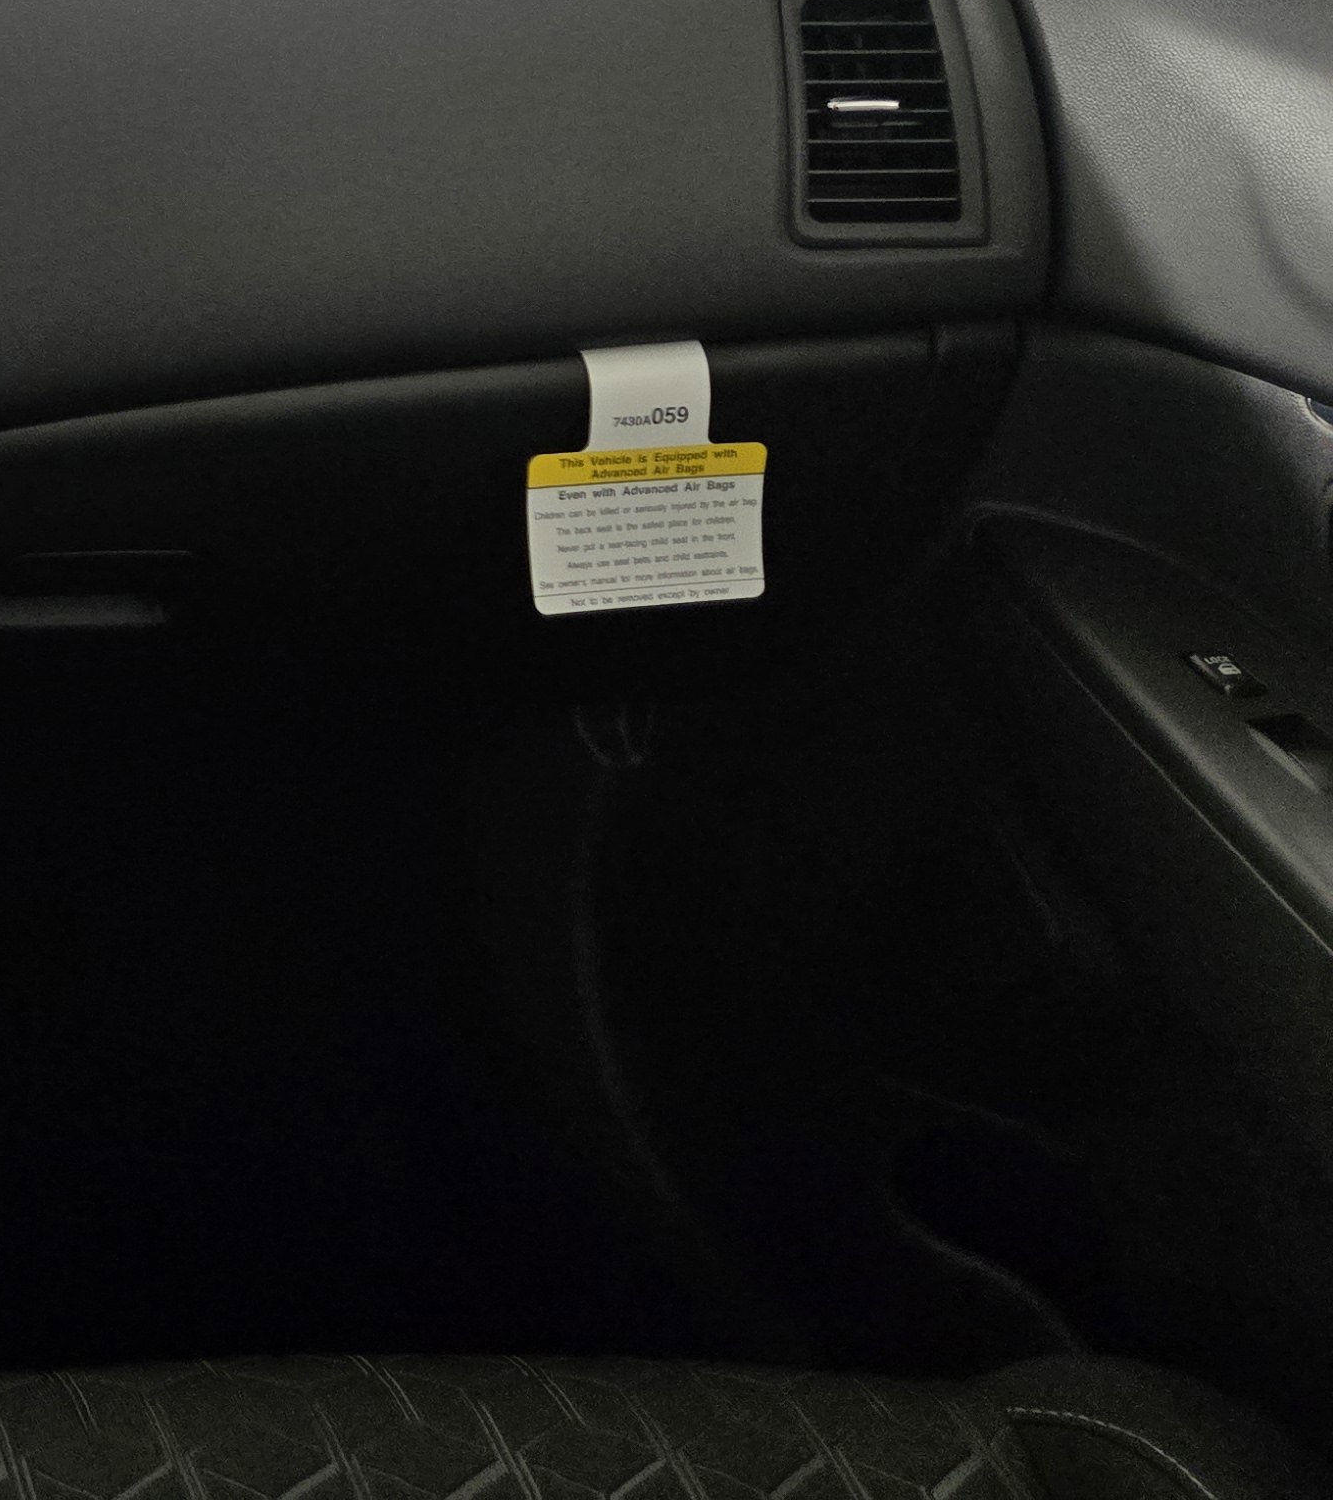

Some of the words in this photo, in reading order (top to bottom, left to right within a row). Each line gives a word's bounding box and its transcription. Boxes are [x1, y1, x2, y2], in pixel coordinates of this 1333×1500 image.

[560, 458, 584, 469] This
[591, 455, 632, 467] Vehicle
[654, 451, 707, 465] Equipped
[714, 449, 737, 459] with
[592, 467, 647, 479] Advanced
[653, 465, 670, 474] Air
[677, 464, 704, 475] Bags
[559, 490, 586, 500] Even
[593, 487, 616, 498] with
[622, 482, 678, 496] Advanced
[685, 481, 701, 492] Air
[707, 480, 735, 492] Bags
[1203, 655, 1232, 665] LOCK
